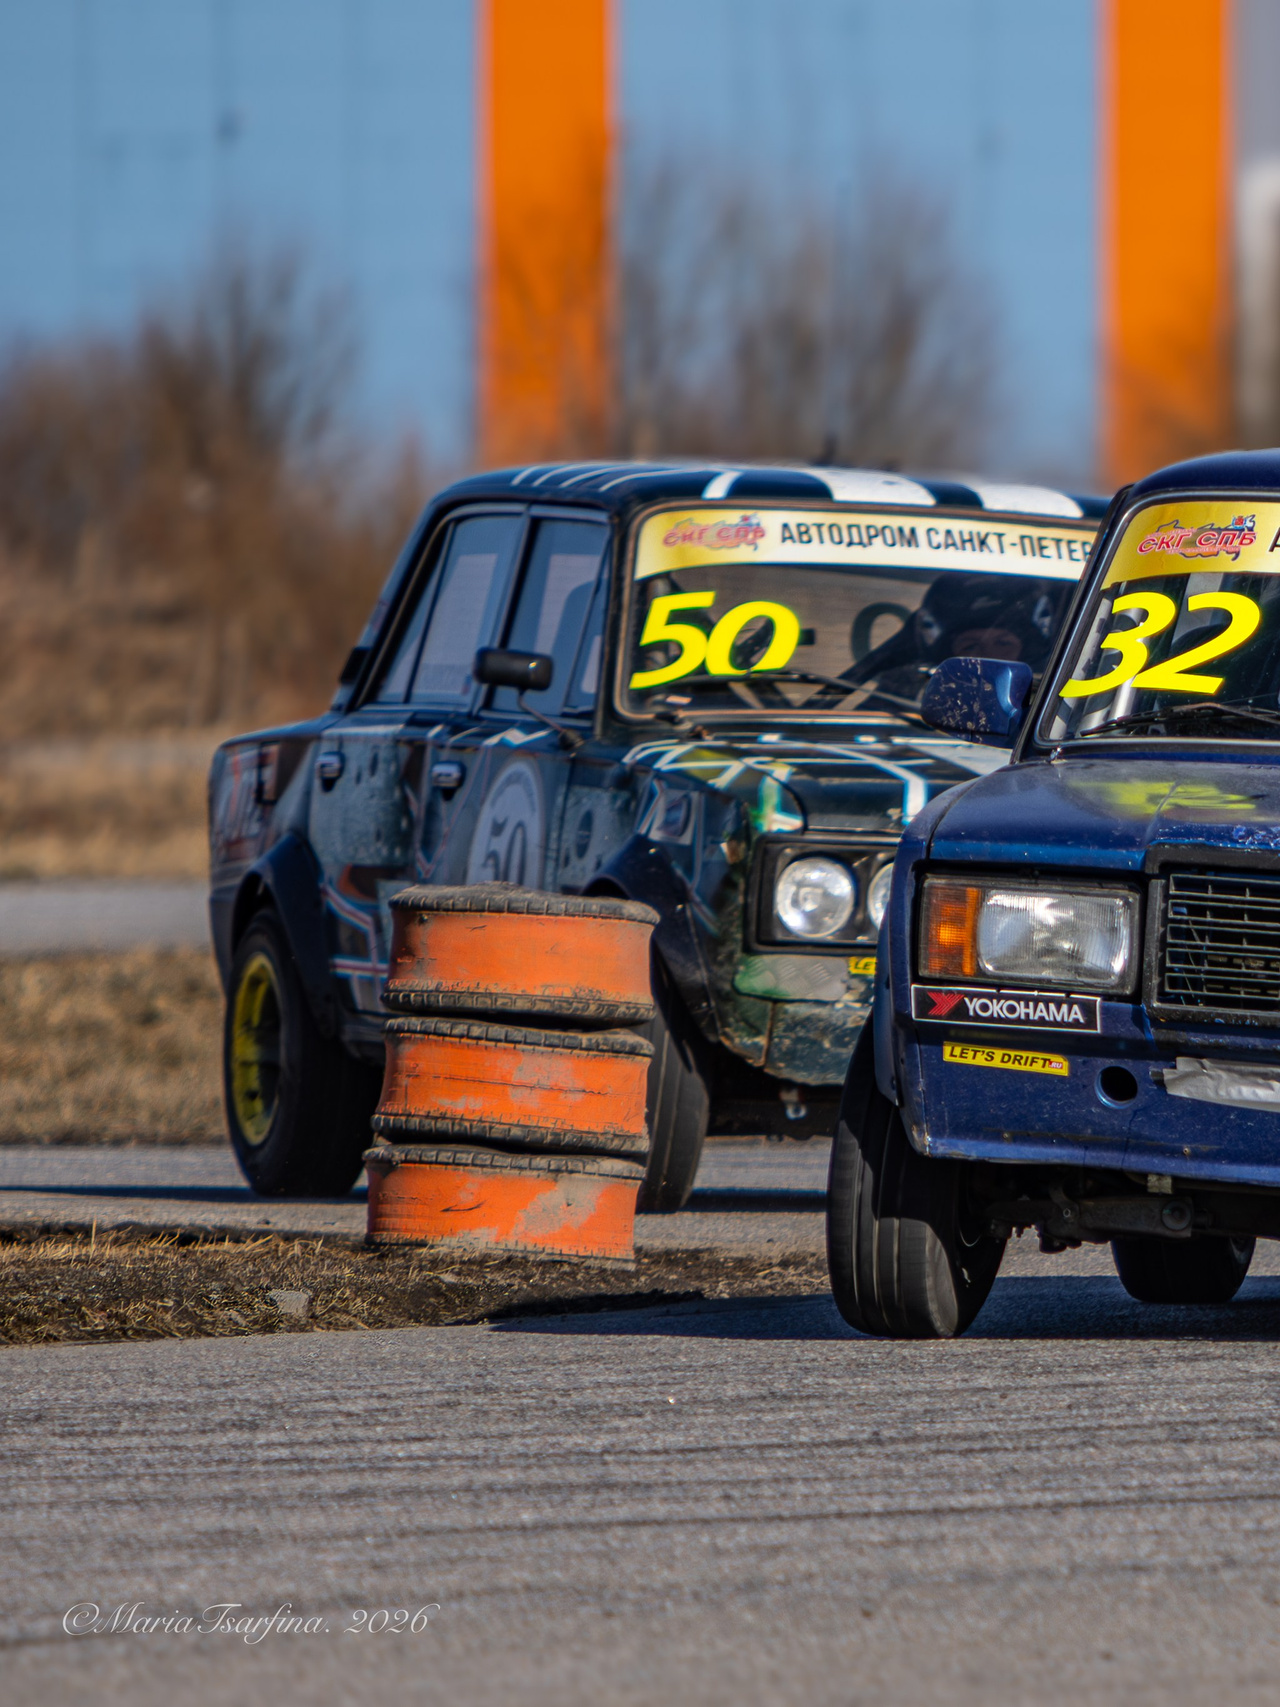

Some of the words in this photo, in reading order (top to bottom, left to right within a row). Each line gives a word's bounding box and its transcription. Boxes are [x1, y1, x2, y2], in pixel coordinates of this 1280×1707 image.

[780, 522, 920, 548] АВТОДРОМ
[1137, 531, 1192, 554] СКГ
[1195, 530, 1258, 548] СПБ
[628, 590, 801, 690] 50
[1060, 591, 1261, 698] 32
[964, 997, 1085, 1023] YOKOHAMA
[949, 1046, 995, 1062] LET'S
